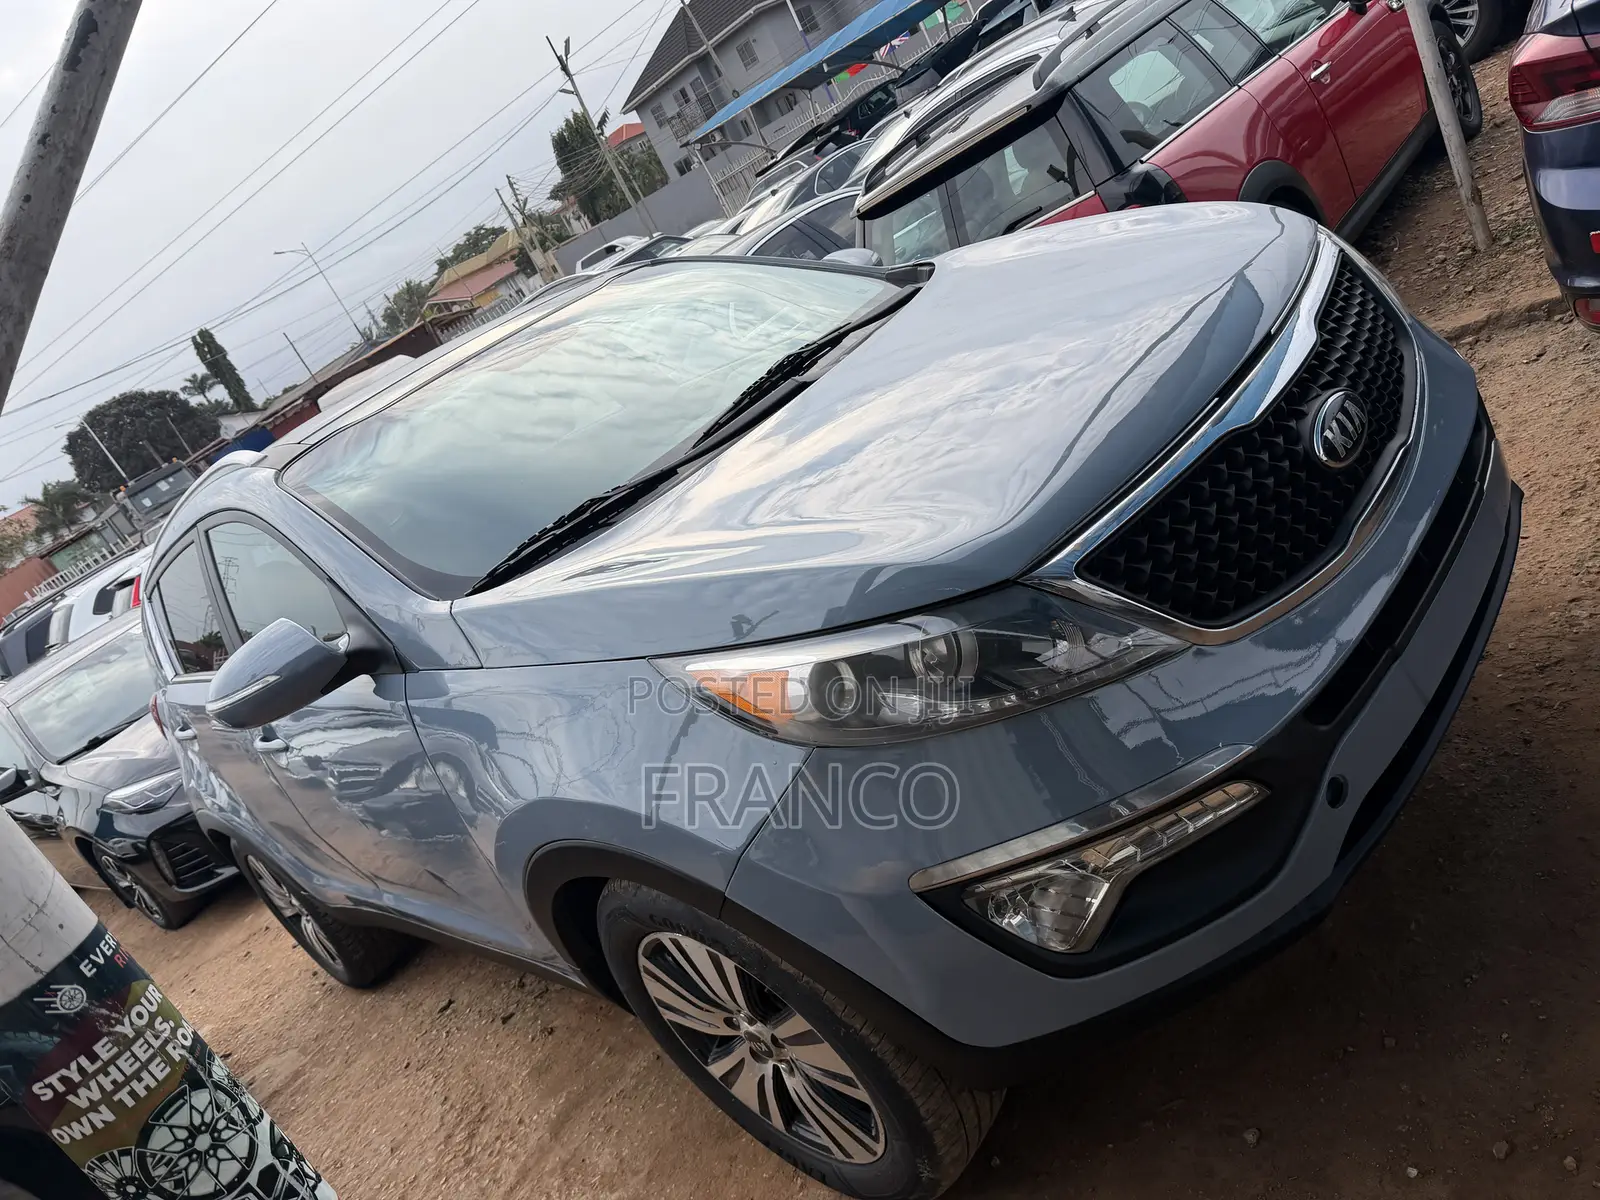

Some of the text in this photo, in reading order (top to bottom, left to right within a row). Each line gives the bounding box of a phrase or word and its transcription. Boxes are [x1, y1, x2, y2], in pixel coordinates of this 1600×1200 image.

[31, 983, 163, 1102] STYLE YOUR
[65, 1016, 175, 1110] WHEELS.
[51, 1103, 116, 1146] OWN
[112, 1058, 171, 1109] THE
